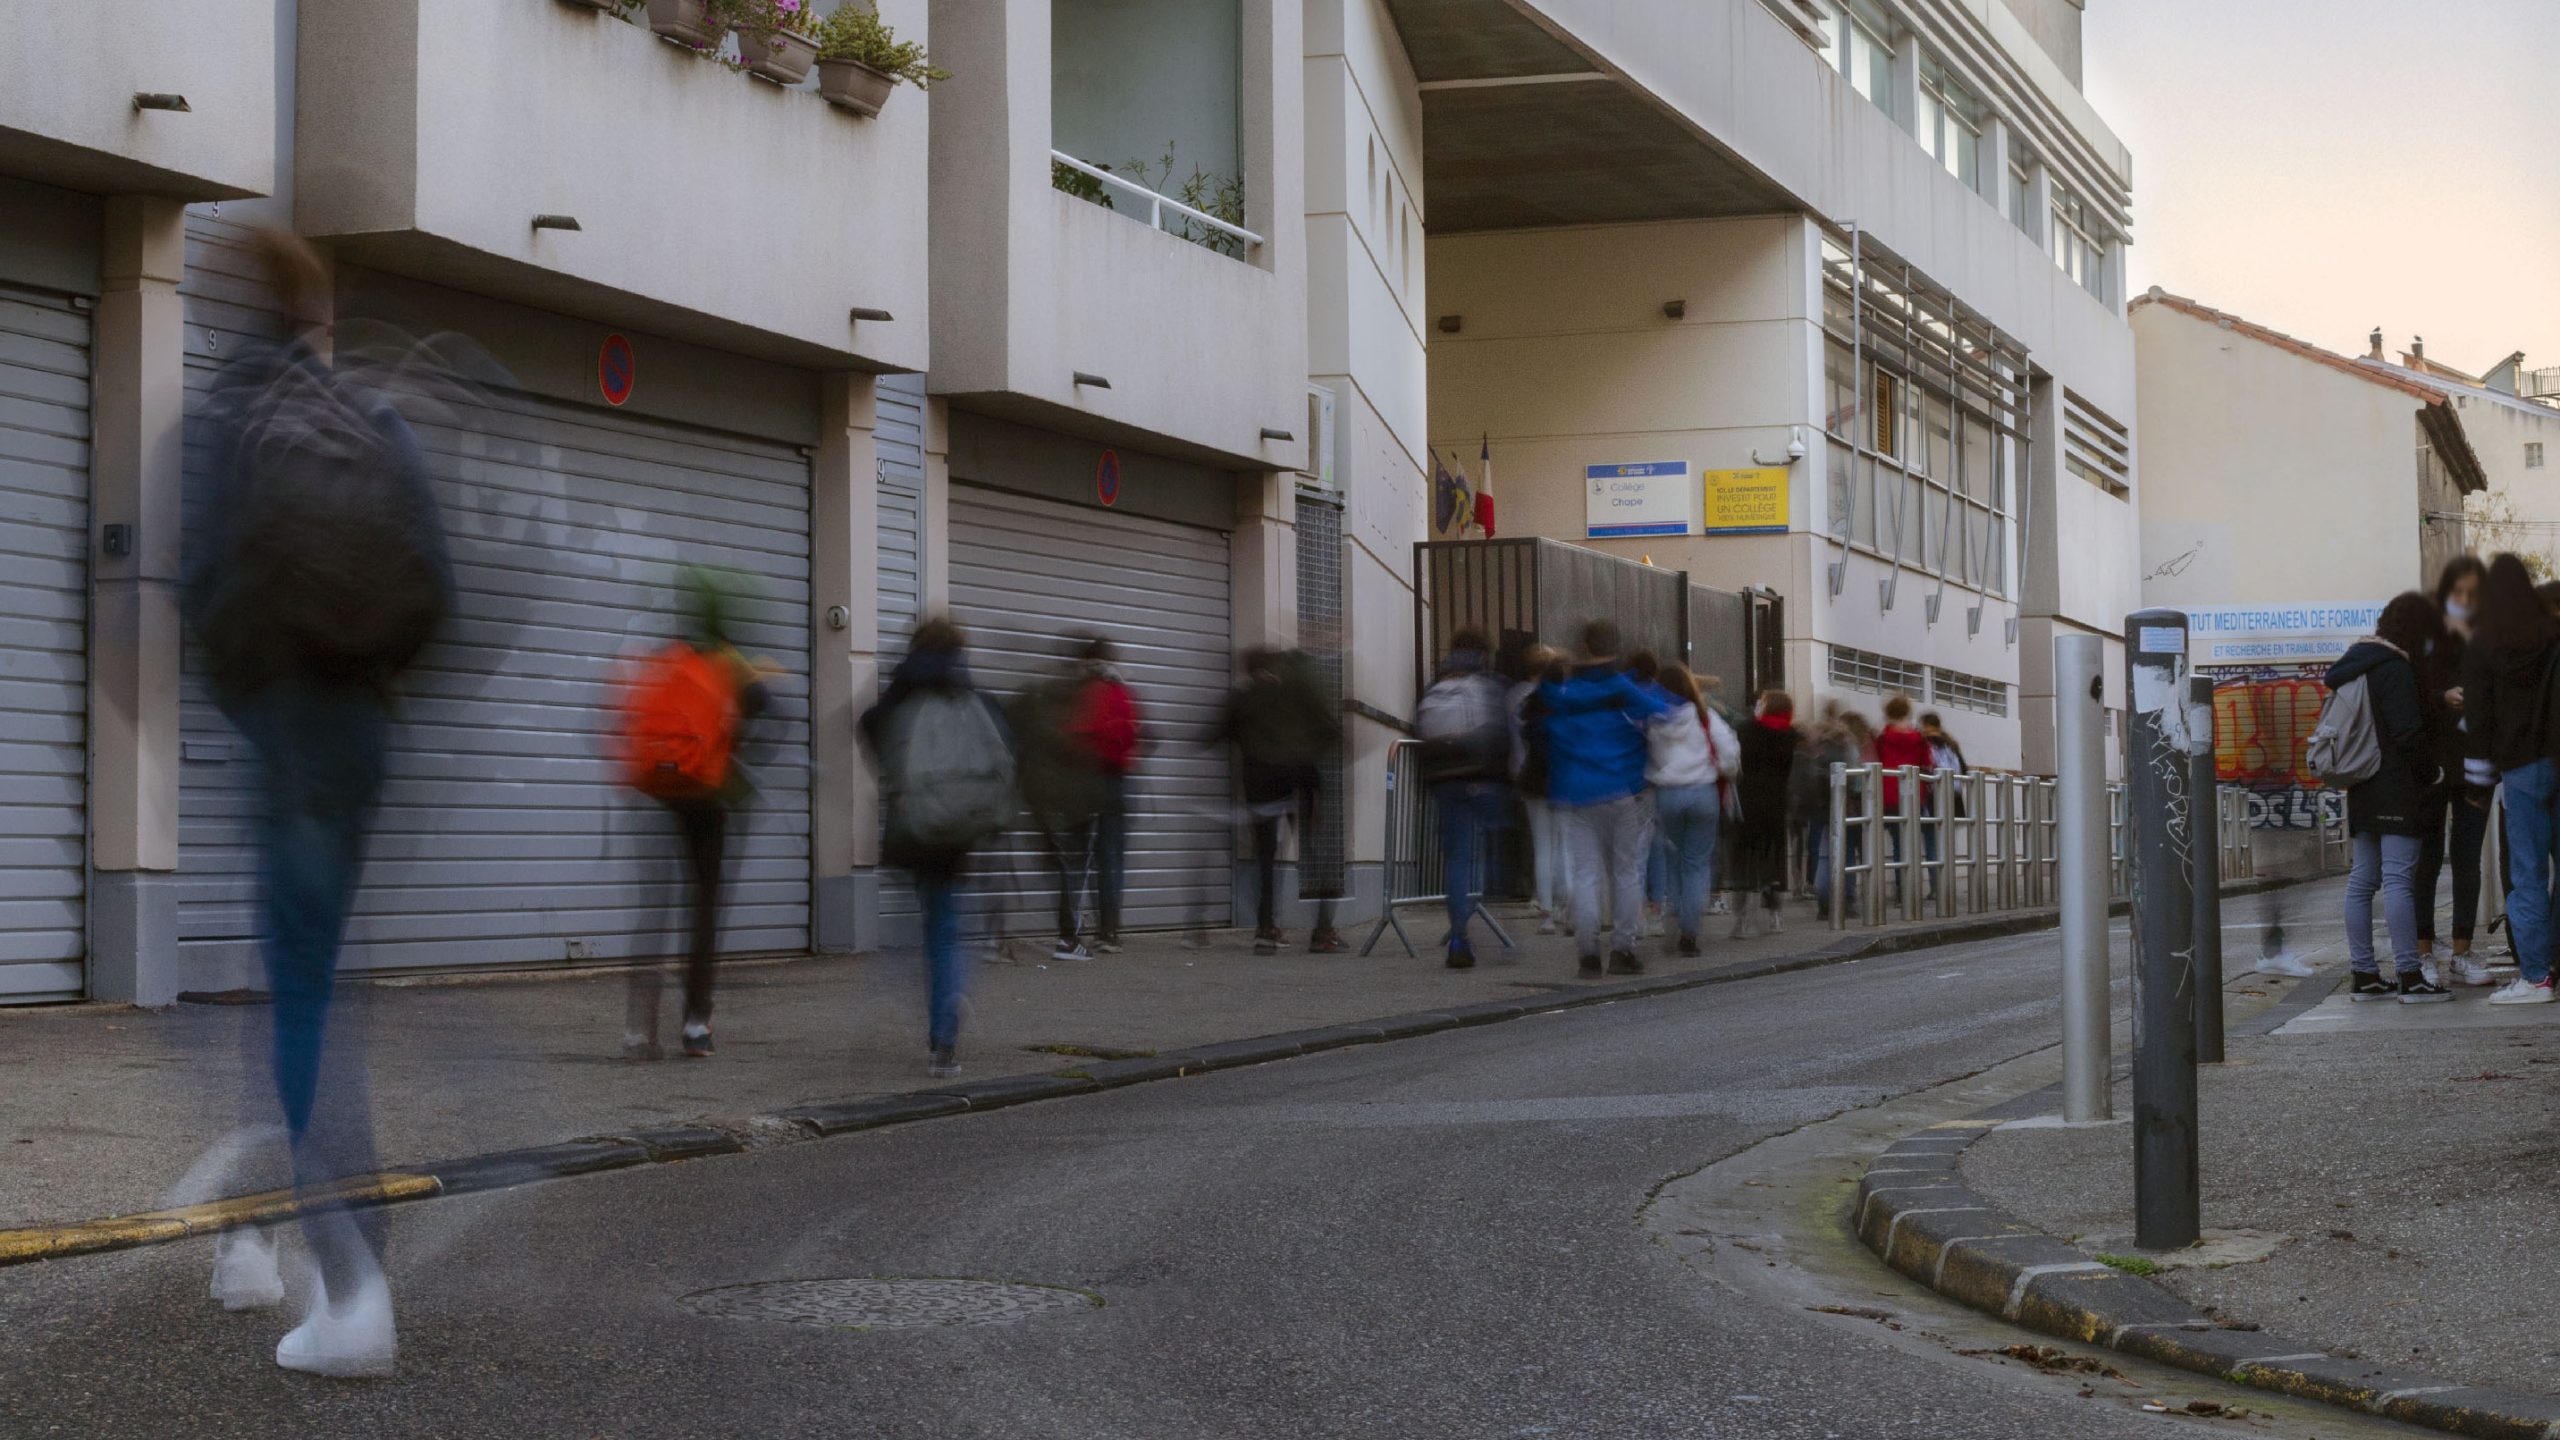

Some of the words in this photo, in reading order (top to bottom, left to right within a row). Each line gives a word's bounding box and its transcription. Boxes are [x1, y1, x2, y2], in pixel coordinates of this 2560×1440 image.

[209, 329, 216, 350] 9
[878, 459, 885, 482] 9
[1610, 481, 1645, 492] Collège
[1611, 498, 1643, 507] Chape
[1716, 505, 1731, 513] UN
[1733, 503, 1777, 513] COLLÈGE
[2214, 610, 2308, 631] MEDITERRANEEN
[2310, 609, 2326, 628] DE
[2328, 608, 2384, 628] FORMATI
[2214, 645, 2225, 657] ET
[2225, 643, 2273, 656] RECHERCHE
[2273, 642, 2285, 655] EN
[2286, 641, 2316, 655] TRAVAIL
[2316, 640, 2345, 654] SOCIAL
